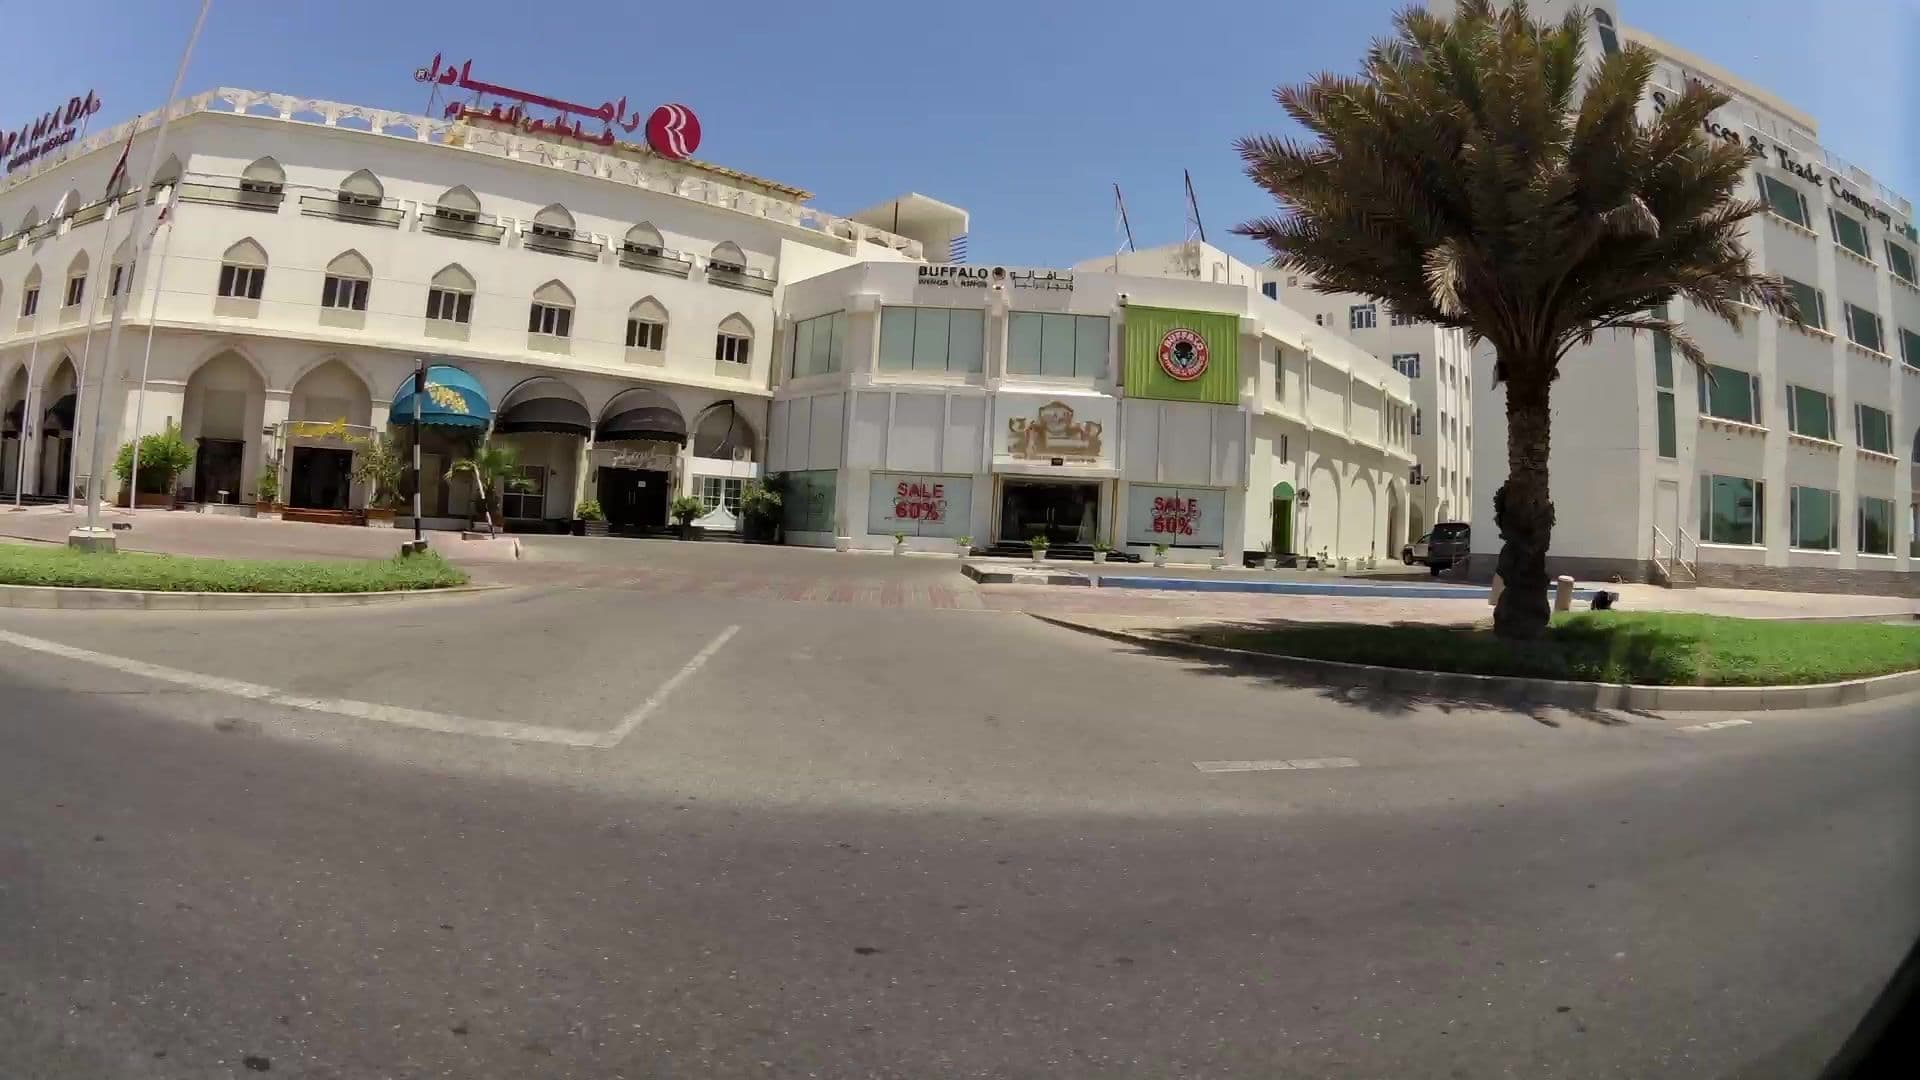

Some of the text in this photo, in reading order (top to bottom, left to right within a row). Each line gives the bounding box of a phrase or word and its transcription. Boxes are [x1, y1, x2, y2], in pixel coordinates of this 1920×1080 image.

[1750, 136, 1768, 160] &
[1773, 144, 1824, 187] Trade
[1829, 176, 1891, 231] Company
[918, 266, 988, 279] BUFFALO
[1164, 331, 1204, 351] BUFFALO
[897, 480, 945, 498] SALE
[1154, 496, 1198, 514] SALE
